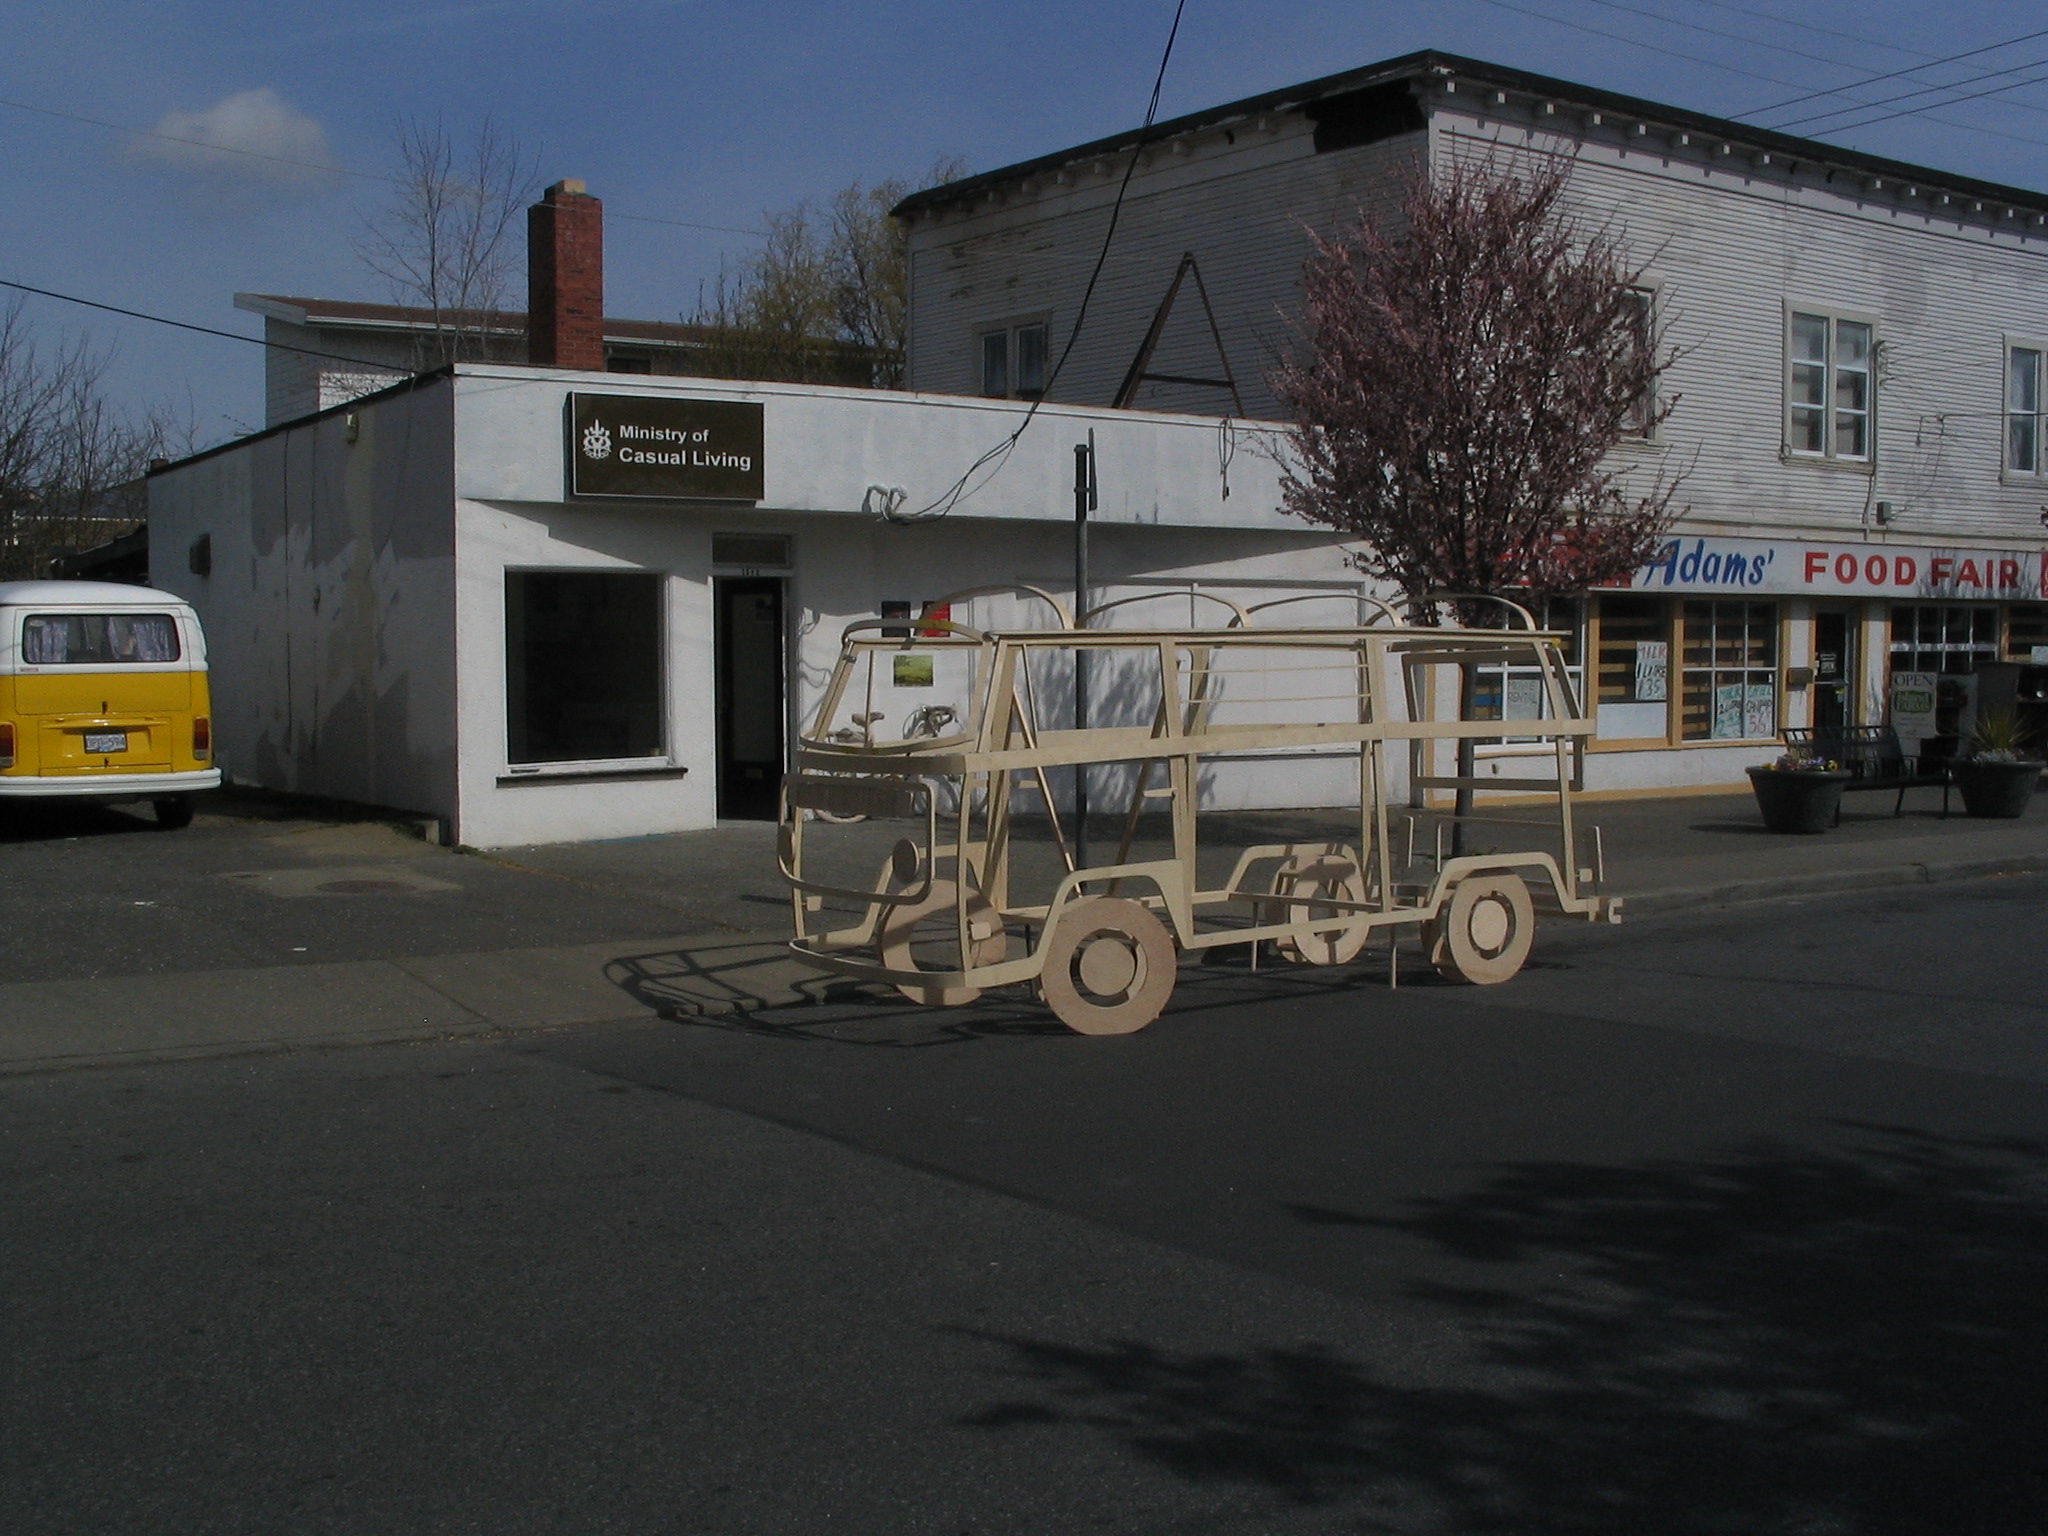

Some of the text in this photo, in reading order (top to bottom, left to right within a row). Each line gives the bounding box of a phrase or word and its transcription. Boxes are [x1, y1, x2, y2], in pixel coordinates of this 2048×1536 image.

[619, 425, 709, 444] Ministry of
[619, 447, 752, 471] Casual Living
[1643, 537, 1775, 587] Adams'
[1804, 551, 1917, 587] FOOD
[1930, 557, 2019, 590] FAIR
[1894, 673, 1935, 687] OPEN
